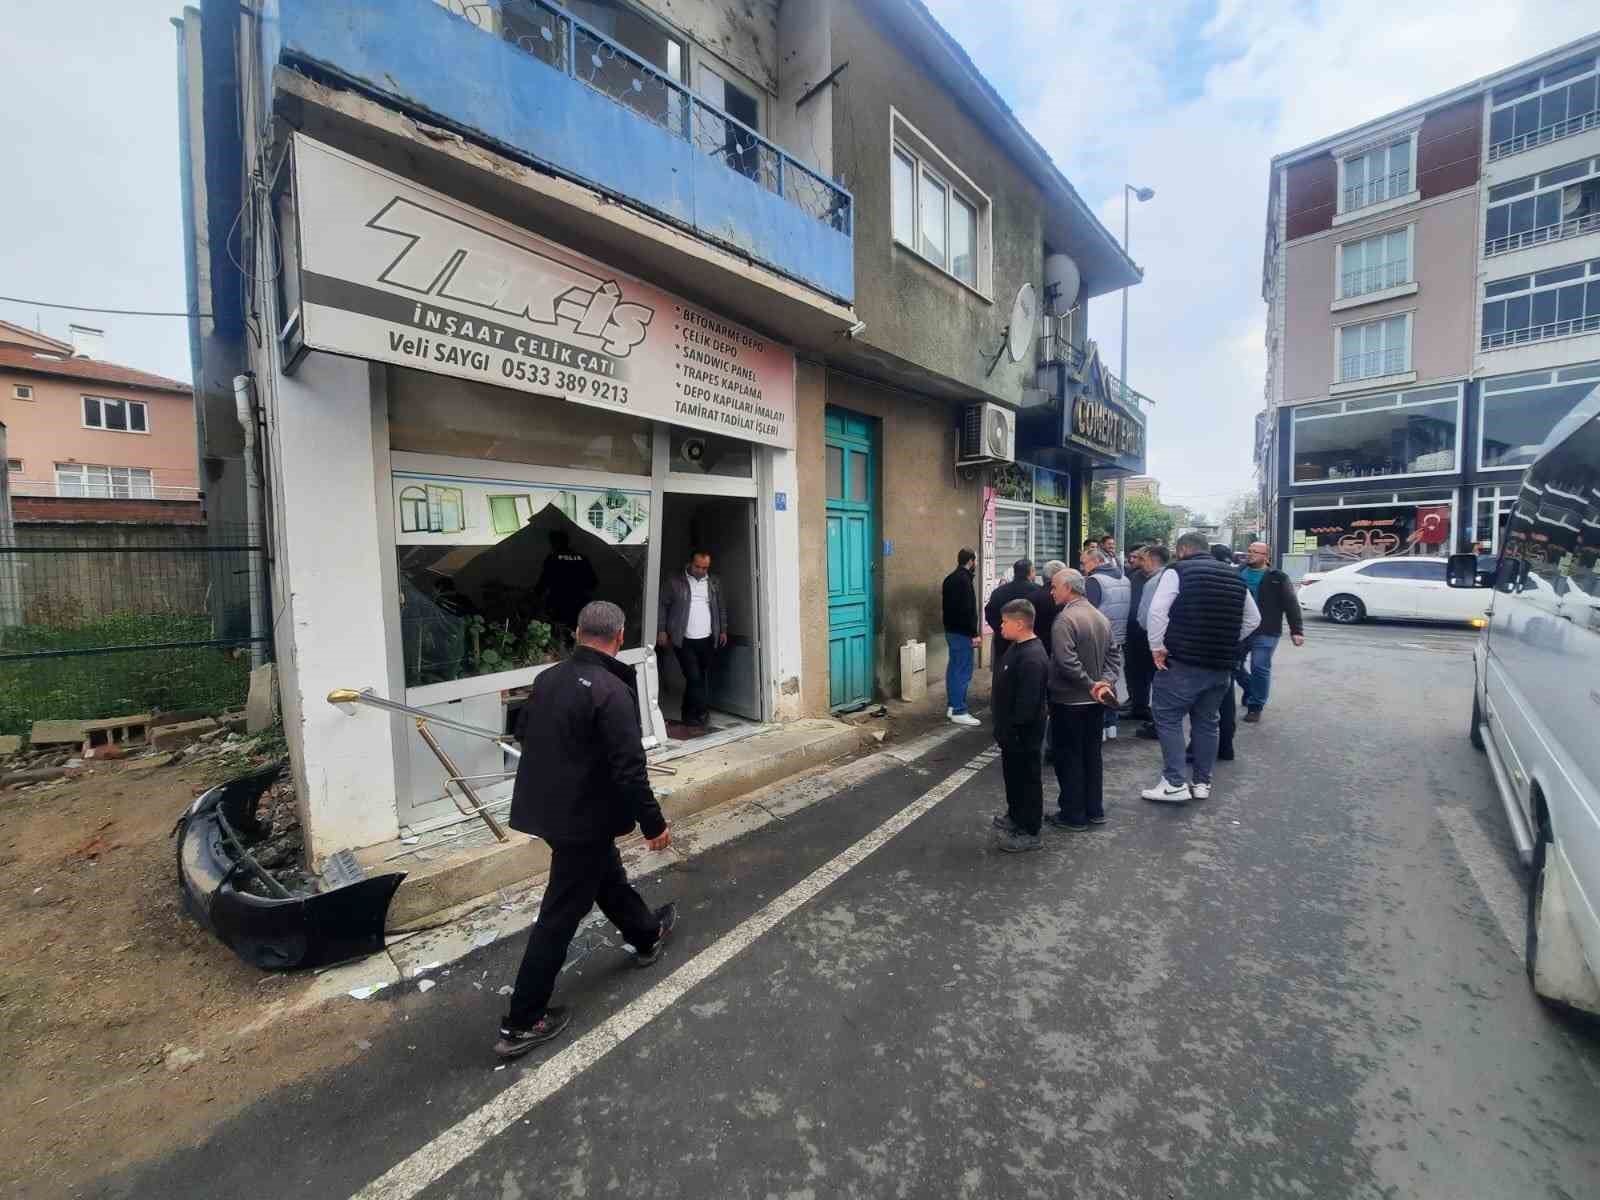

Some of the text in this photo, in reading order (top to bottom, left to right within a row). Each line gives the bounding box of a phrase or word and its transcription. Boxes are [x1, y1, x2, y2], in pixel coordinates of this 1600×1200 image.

[412, 303, 616, 376] İNŞAAT ÇELİK ÇATI
[682, 327, 737, 358] ÇELİK DEPO
[683, 309, 764, 353] BETONARME DEPO
[388, 330, 629, 405] Veli SAYGI 0533 389 9213
[683, 365, 762, 401] TRAPES KAPLAMA
[731, 363, 757, 383] PANEL
[674, 400, 720, 421] TAMİRAT
[720, 411, 755, 431] TADİLAT
[683, 384, 711, 401] DEPO
[713, 392, 753, 414] KAPILARI
